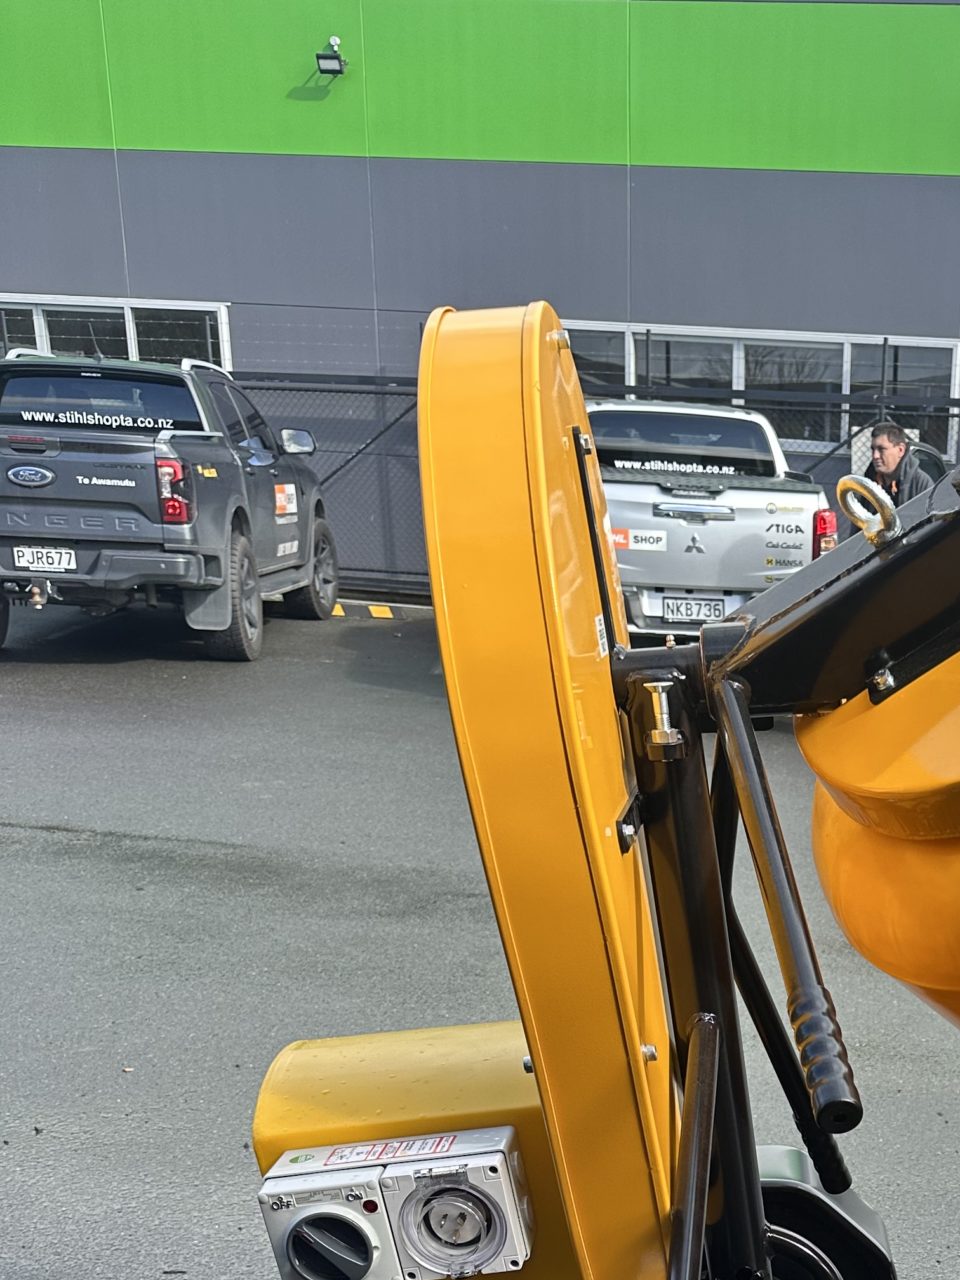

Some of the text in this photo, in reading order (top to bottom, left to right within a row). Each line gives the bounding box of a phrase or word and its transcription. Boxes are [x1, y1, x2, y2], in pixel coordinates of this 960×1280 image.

[21, 410, 174, 429] www.stihlshopta.co.nz
[614, 460, 735, 475] www.stihlshopta.co.nz
[76, 476, 136, 487] Te Awamutu
[765, 524, 805, 534] STIGA
[633, 535, 663, 544] SHOP
[15, 550, 73, 566] PJR677
[775, 559, 804, 567] HANSA
[666, 602, 722, 618] NKB736
[346, 1192, 364, 1202] ON
[271, 1200, 292, 1211] OFF
